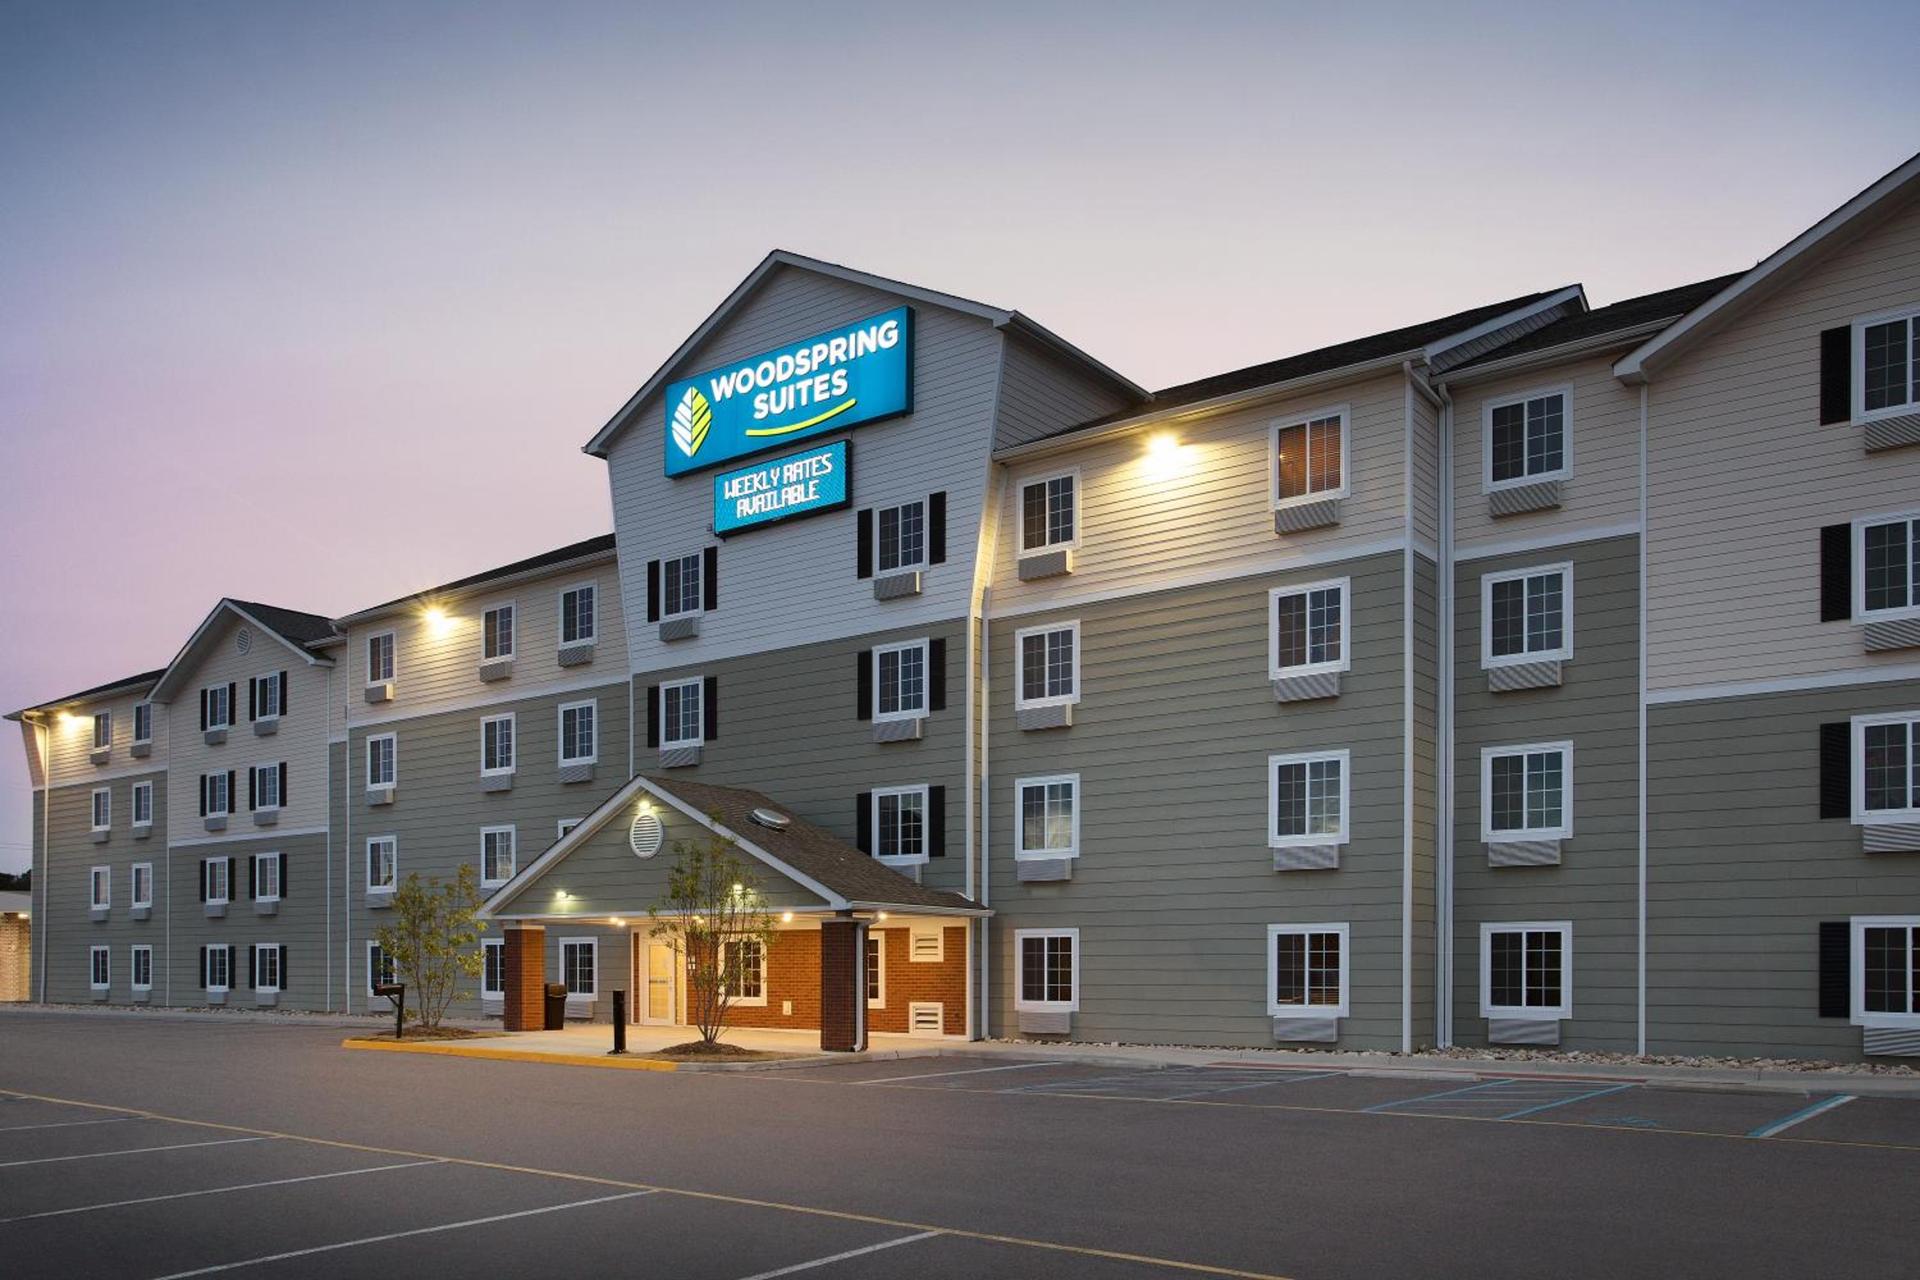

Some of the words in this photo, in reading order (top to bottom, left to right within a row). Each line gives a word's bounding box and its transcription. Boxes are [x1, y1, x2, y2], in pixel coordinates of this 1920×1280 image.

[710, 320, 899, 402] WOODSPRING
[753, 369, 848, 419] SUITES
[724, 467, 780, 499] WEEKLY
[783, 453, 833, 484] RATES
[736, 479, 820, 519] AVAILABLE
